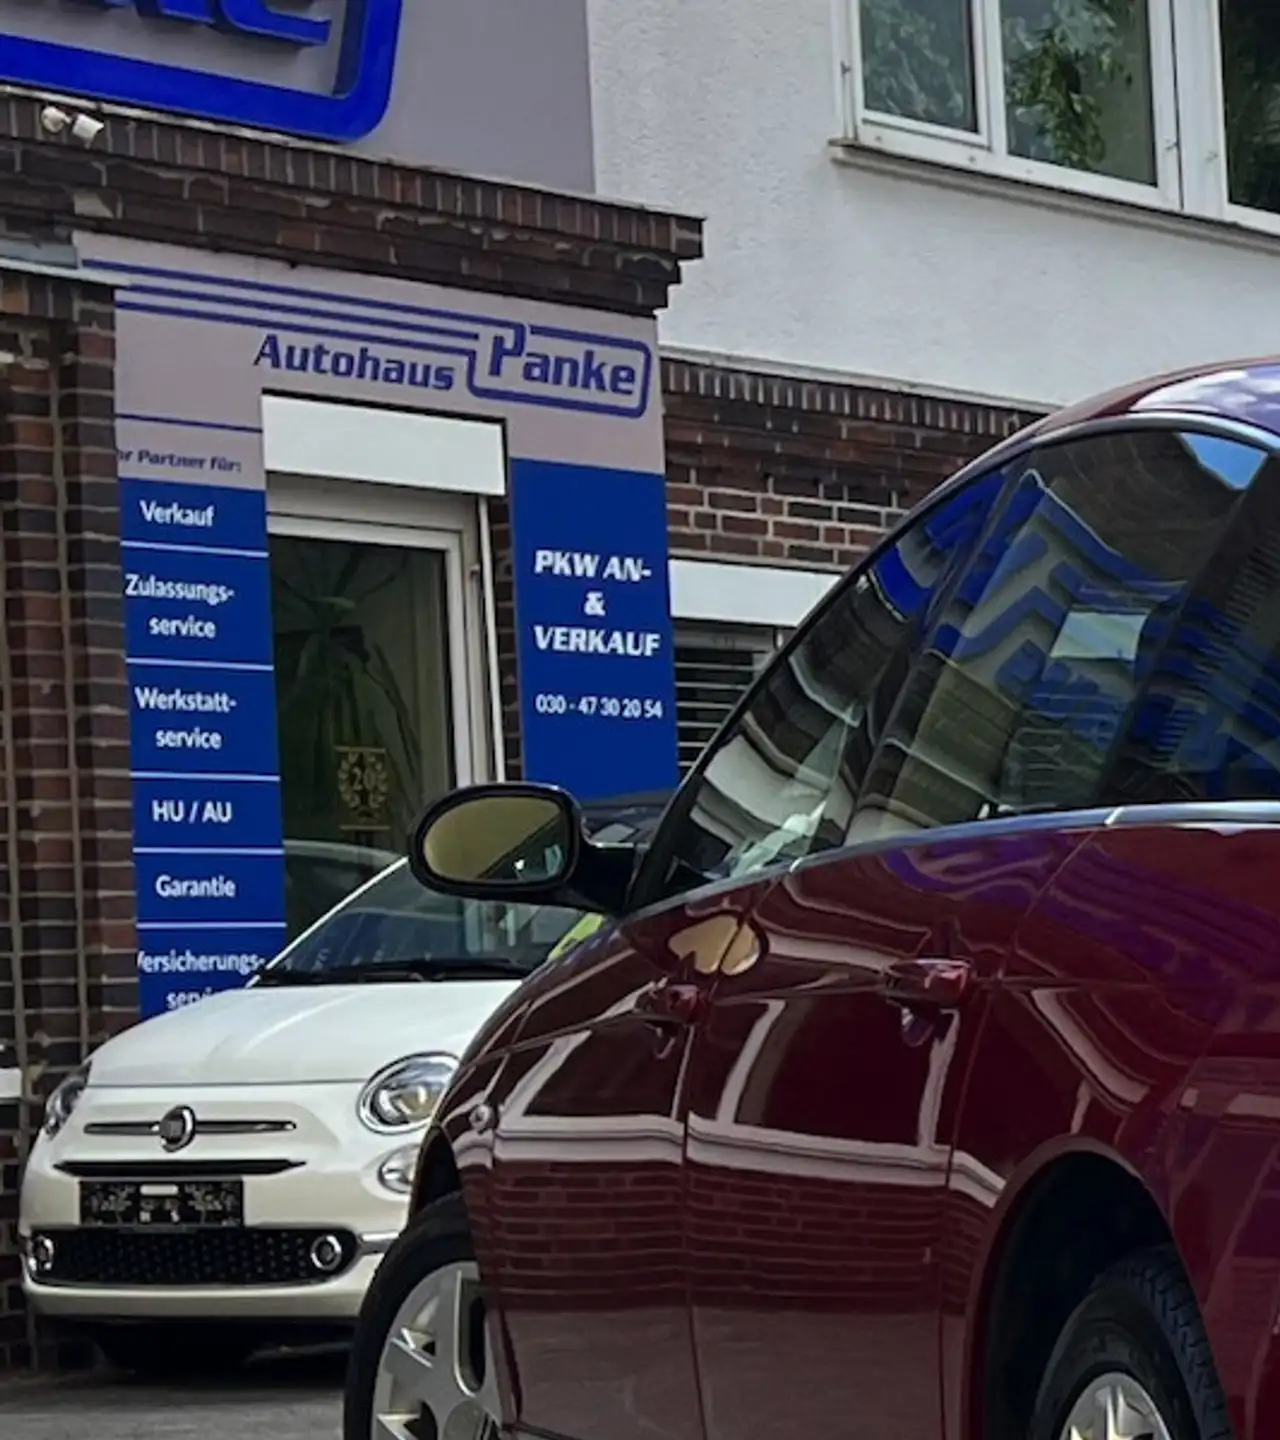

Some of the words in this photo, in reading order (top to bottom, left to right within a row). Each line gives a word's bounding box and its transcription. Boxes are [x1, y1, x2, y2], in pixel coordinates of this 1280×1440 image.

[253, 333, 455, 391] Autohaus
[488, 328, 637, 396] Panke
[137, 448, 205, 470] Partner
[139, 499, 215, 527] Verkauf
[534, 549, 600, 578] PKW
[602, 556, 652, 582] AN-
[125, 573, 234, 606] Zulassungs-
[583, 591, 606, 617] &
[149, 615, 217, 639] service
[533, 625, 661, 657] VERKAUF
[134, 686, 237, 713] Werkstatt-
[535, 693, 567, 715] 030
[156, 726, 223, 750] service
[152, 800, 185, 823] HU
[201, 801, 233, 824] AU
[155, 873, 237, 898] Garantie
